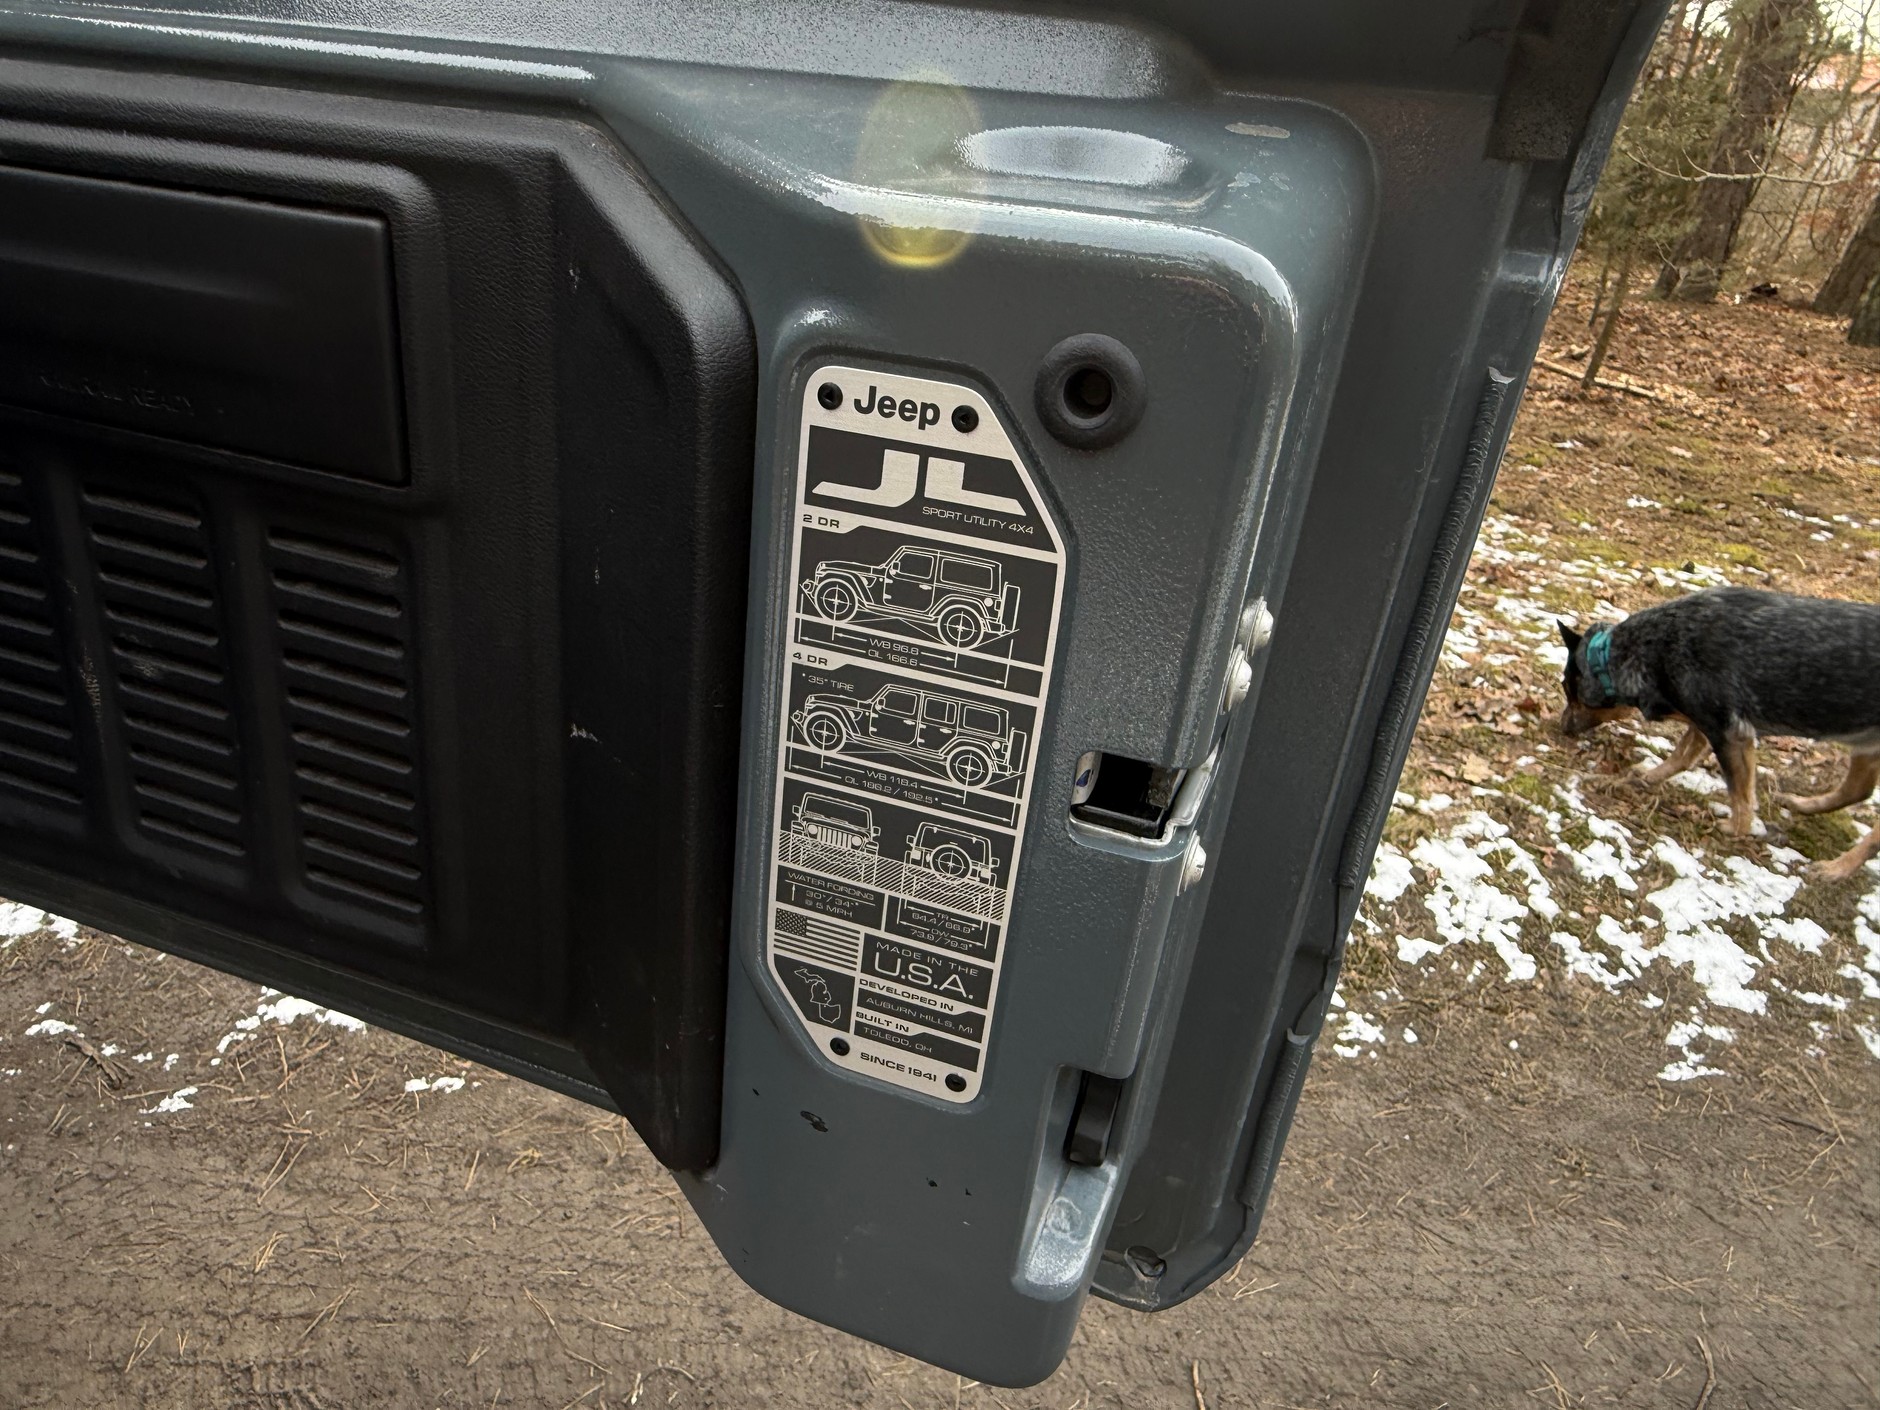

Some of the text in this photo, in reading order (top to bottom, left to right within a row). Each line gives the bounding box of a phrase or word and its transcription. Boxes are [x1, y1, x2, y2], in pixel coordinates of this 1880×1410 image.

[854, 385, 941, 431] Jeep
[811, 449, 1027, 517] JL
[803, 514, 840, 529] 2 DR
[922, 506, 1034, 535] SPORT UTILITY 4X4
[792, 651, 828, 666] 4 DR
[868, 649, 918, 666] OL 166.6
[869, 638, 919, 656] WB 96.8
[830, 680, 854, 692] TIRE
[844, 775, 859, 786] OL
[866, 770, 918, 788] WB 118.4
[787, 871, 875, 901] WATER FORDING
[826, 904, 853, 918] MPH
[877, 942, 978, 977] MADE IN THE
[874, 952, 974, 999] U.S.A.
[859, 978, 954, 1012] DEVELOPED IN
[856, 1011, 909, 1033] BUILT IN
[866, 997, 917, 1018] AUBURN
[958, 1024, 973, 1034] MI
[864, 1026, 932, 1053] TOLEDO, OH
[860, 1052, 937, 1082] SINCE 1941
